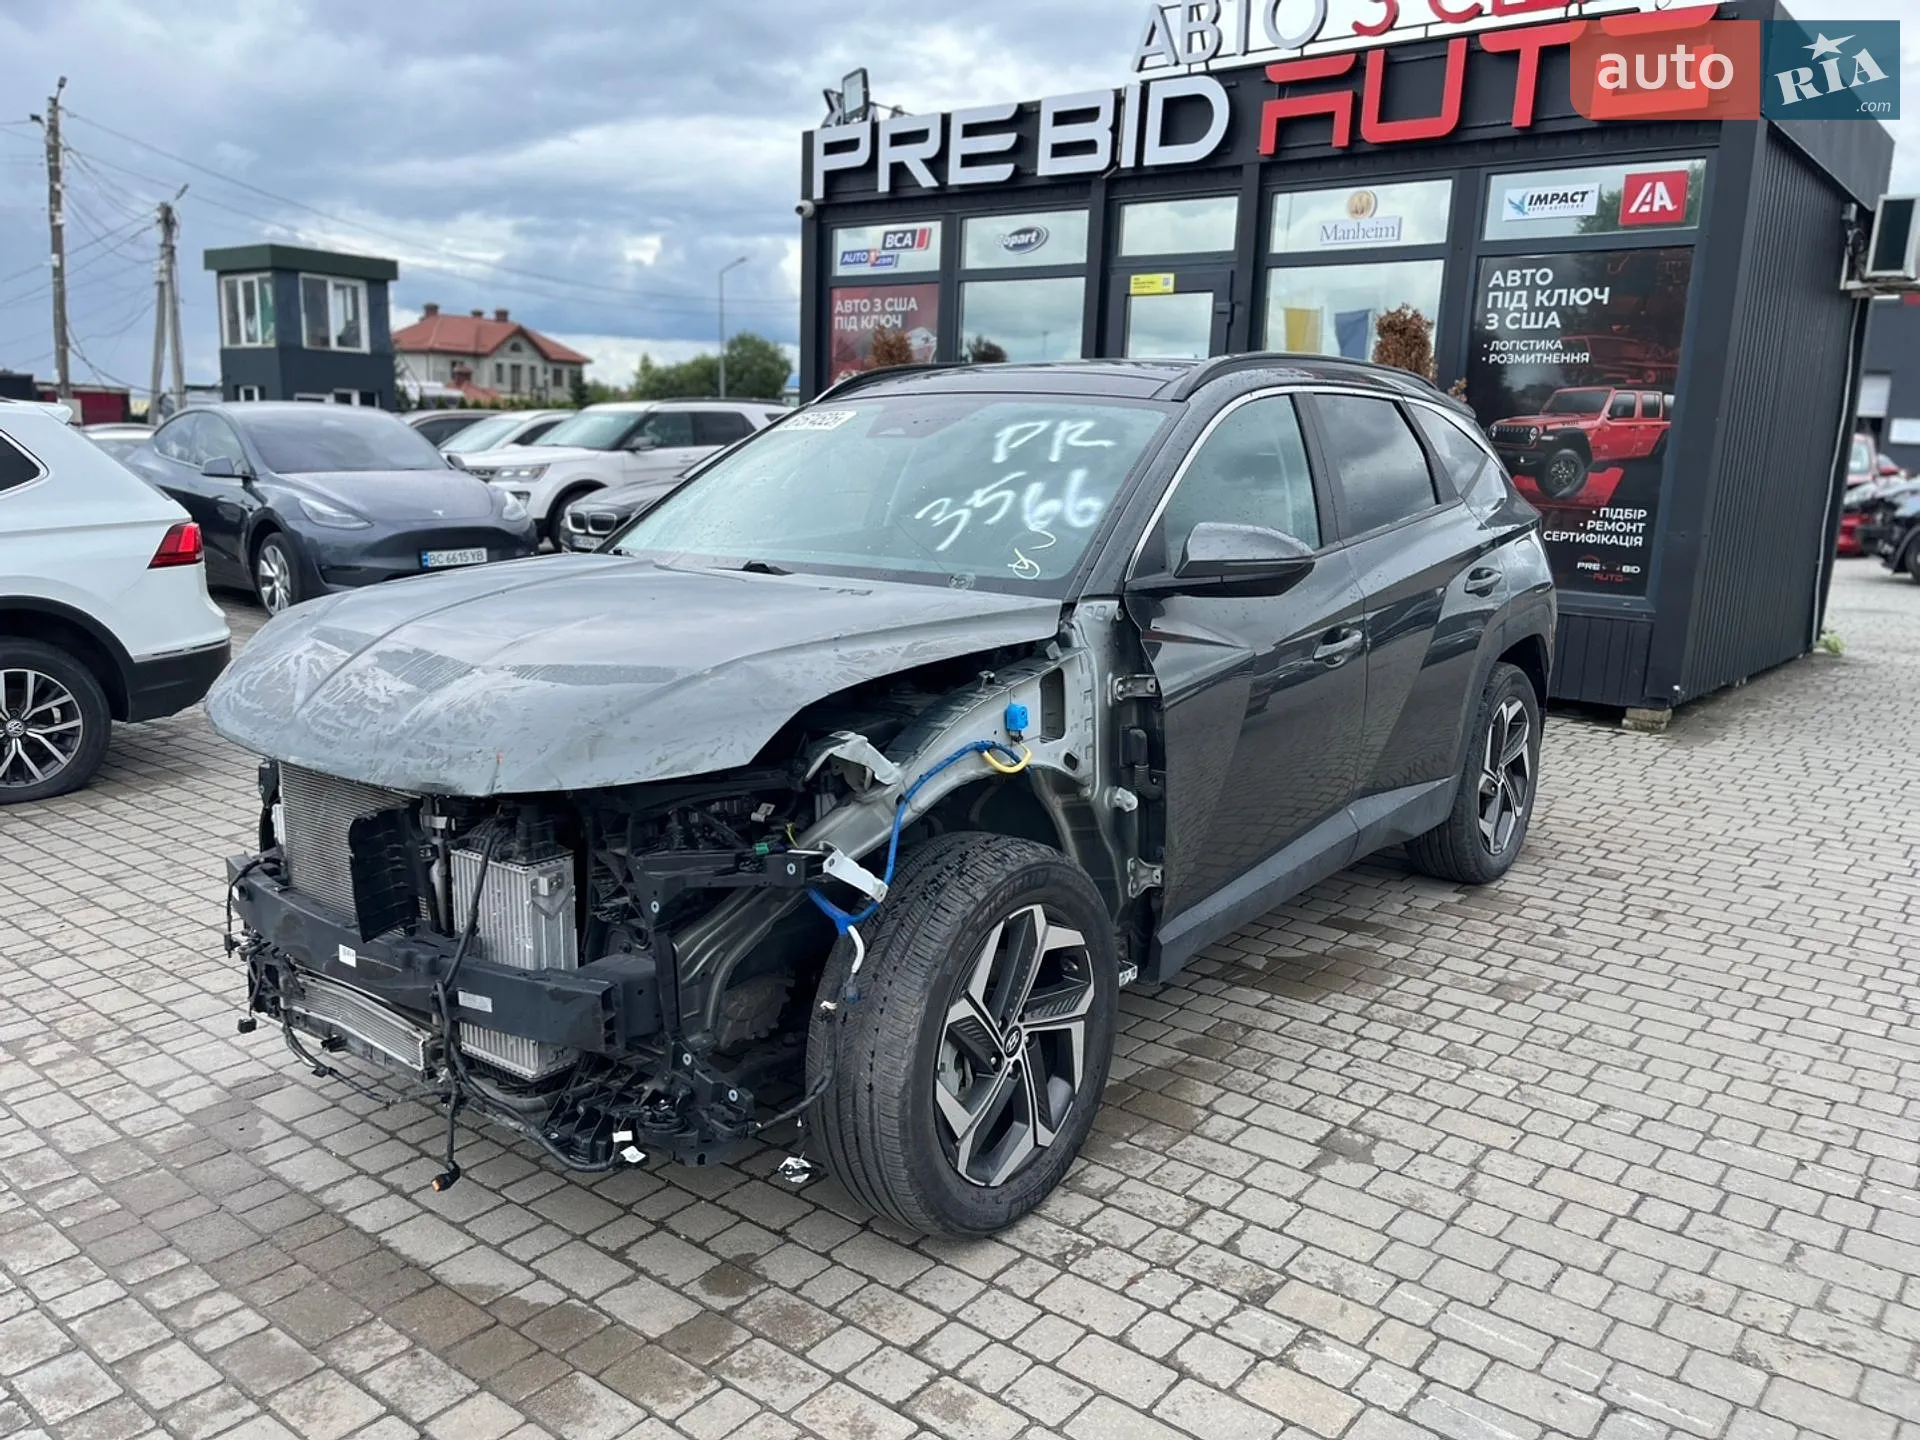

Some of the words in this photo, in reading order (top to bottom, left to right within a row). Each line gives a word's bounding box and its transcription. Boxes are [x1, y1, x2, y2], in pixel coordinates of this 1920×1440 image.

[813, 103, 1019, 200] PRE
[1037, 76, 1231, 177] BID
[1528, 190, 1589, 207] IMPACT
[885, 232, 912, 248] BCA
[1320, 221, 1396, 242] Manheim
[1488, 268, 1553, 288] АВТО
[835, 299, 870, 314] АВТО
[884, 297, 918, 312] США
[1487, 290, 1528, 311] ПІД
[1535, 287, 1610, 307] КЛЮЧ
[834, 315, 858, 331] ПІД
[861, 314, 903, 329] КЛЮЧ
[1505, 311, 1561, 329] США
[1489, 340, 1563, 351] ЛОГІСТИКА
[1488, 352, 1590, 364] РОЗМИТНЕННЯ
[914, 468, 1105, 551] 3566
[1599, 507, 1648, 521] ПІДБІР
[1586, 520, 1646, 534] РЕМОНТ
[1543, 530, 1644, 548] СЕРТИФІКАЦІЯ
